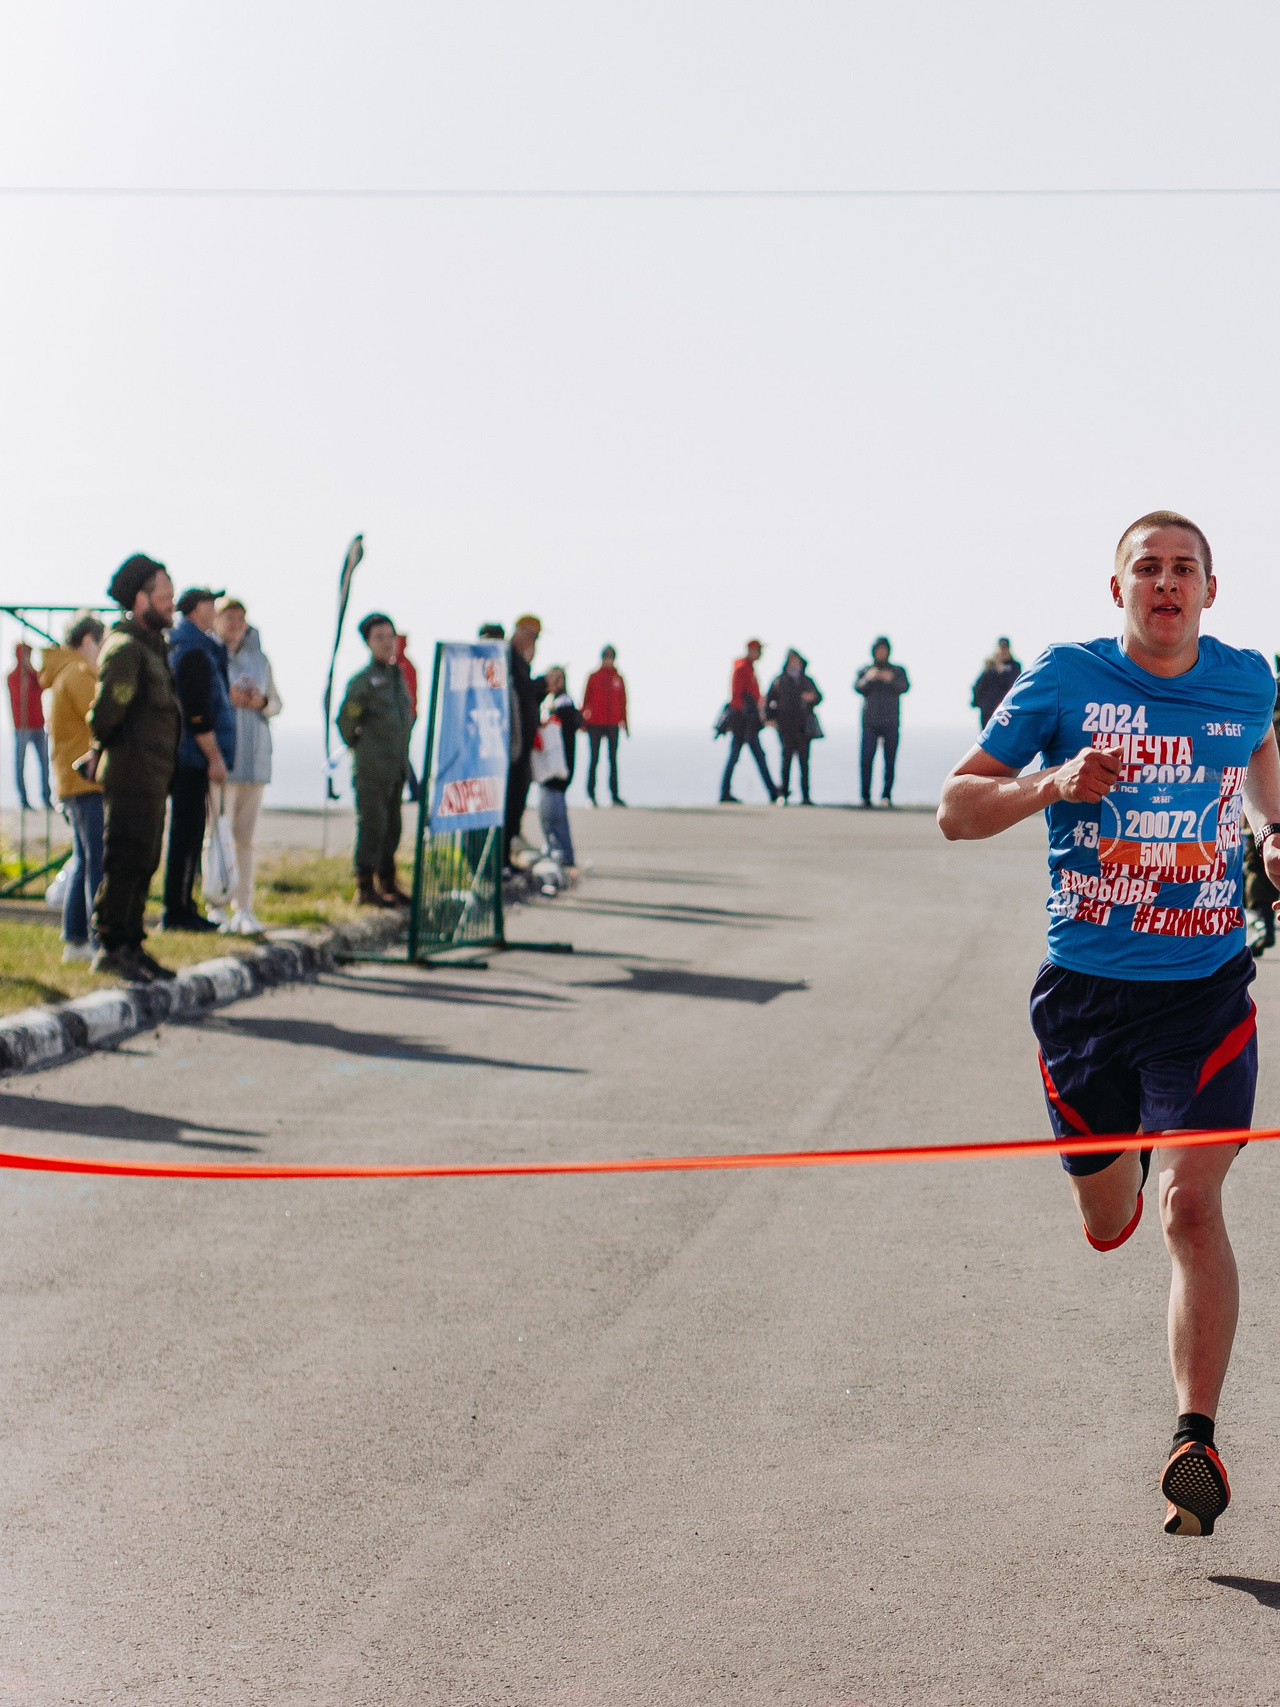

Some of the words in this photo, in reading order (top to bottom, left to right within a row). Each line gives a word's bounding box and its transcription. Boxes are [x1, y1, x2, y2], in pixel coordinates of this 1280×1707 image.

[1082, 702, 1149, 734] 2024
[1092, 733, 1194, 764] #МЕЧТА
[1120, 785, 1139, 794] ПСБ
[1125, 810, 1197, 840] 20072
